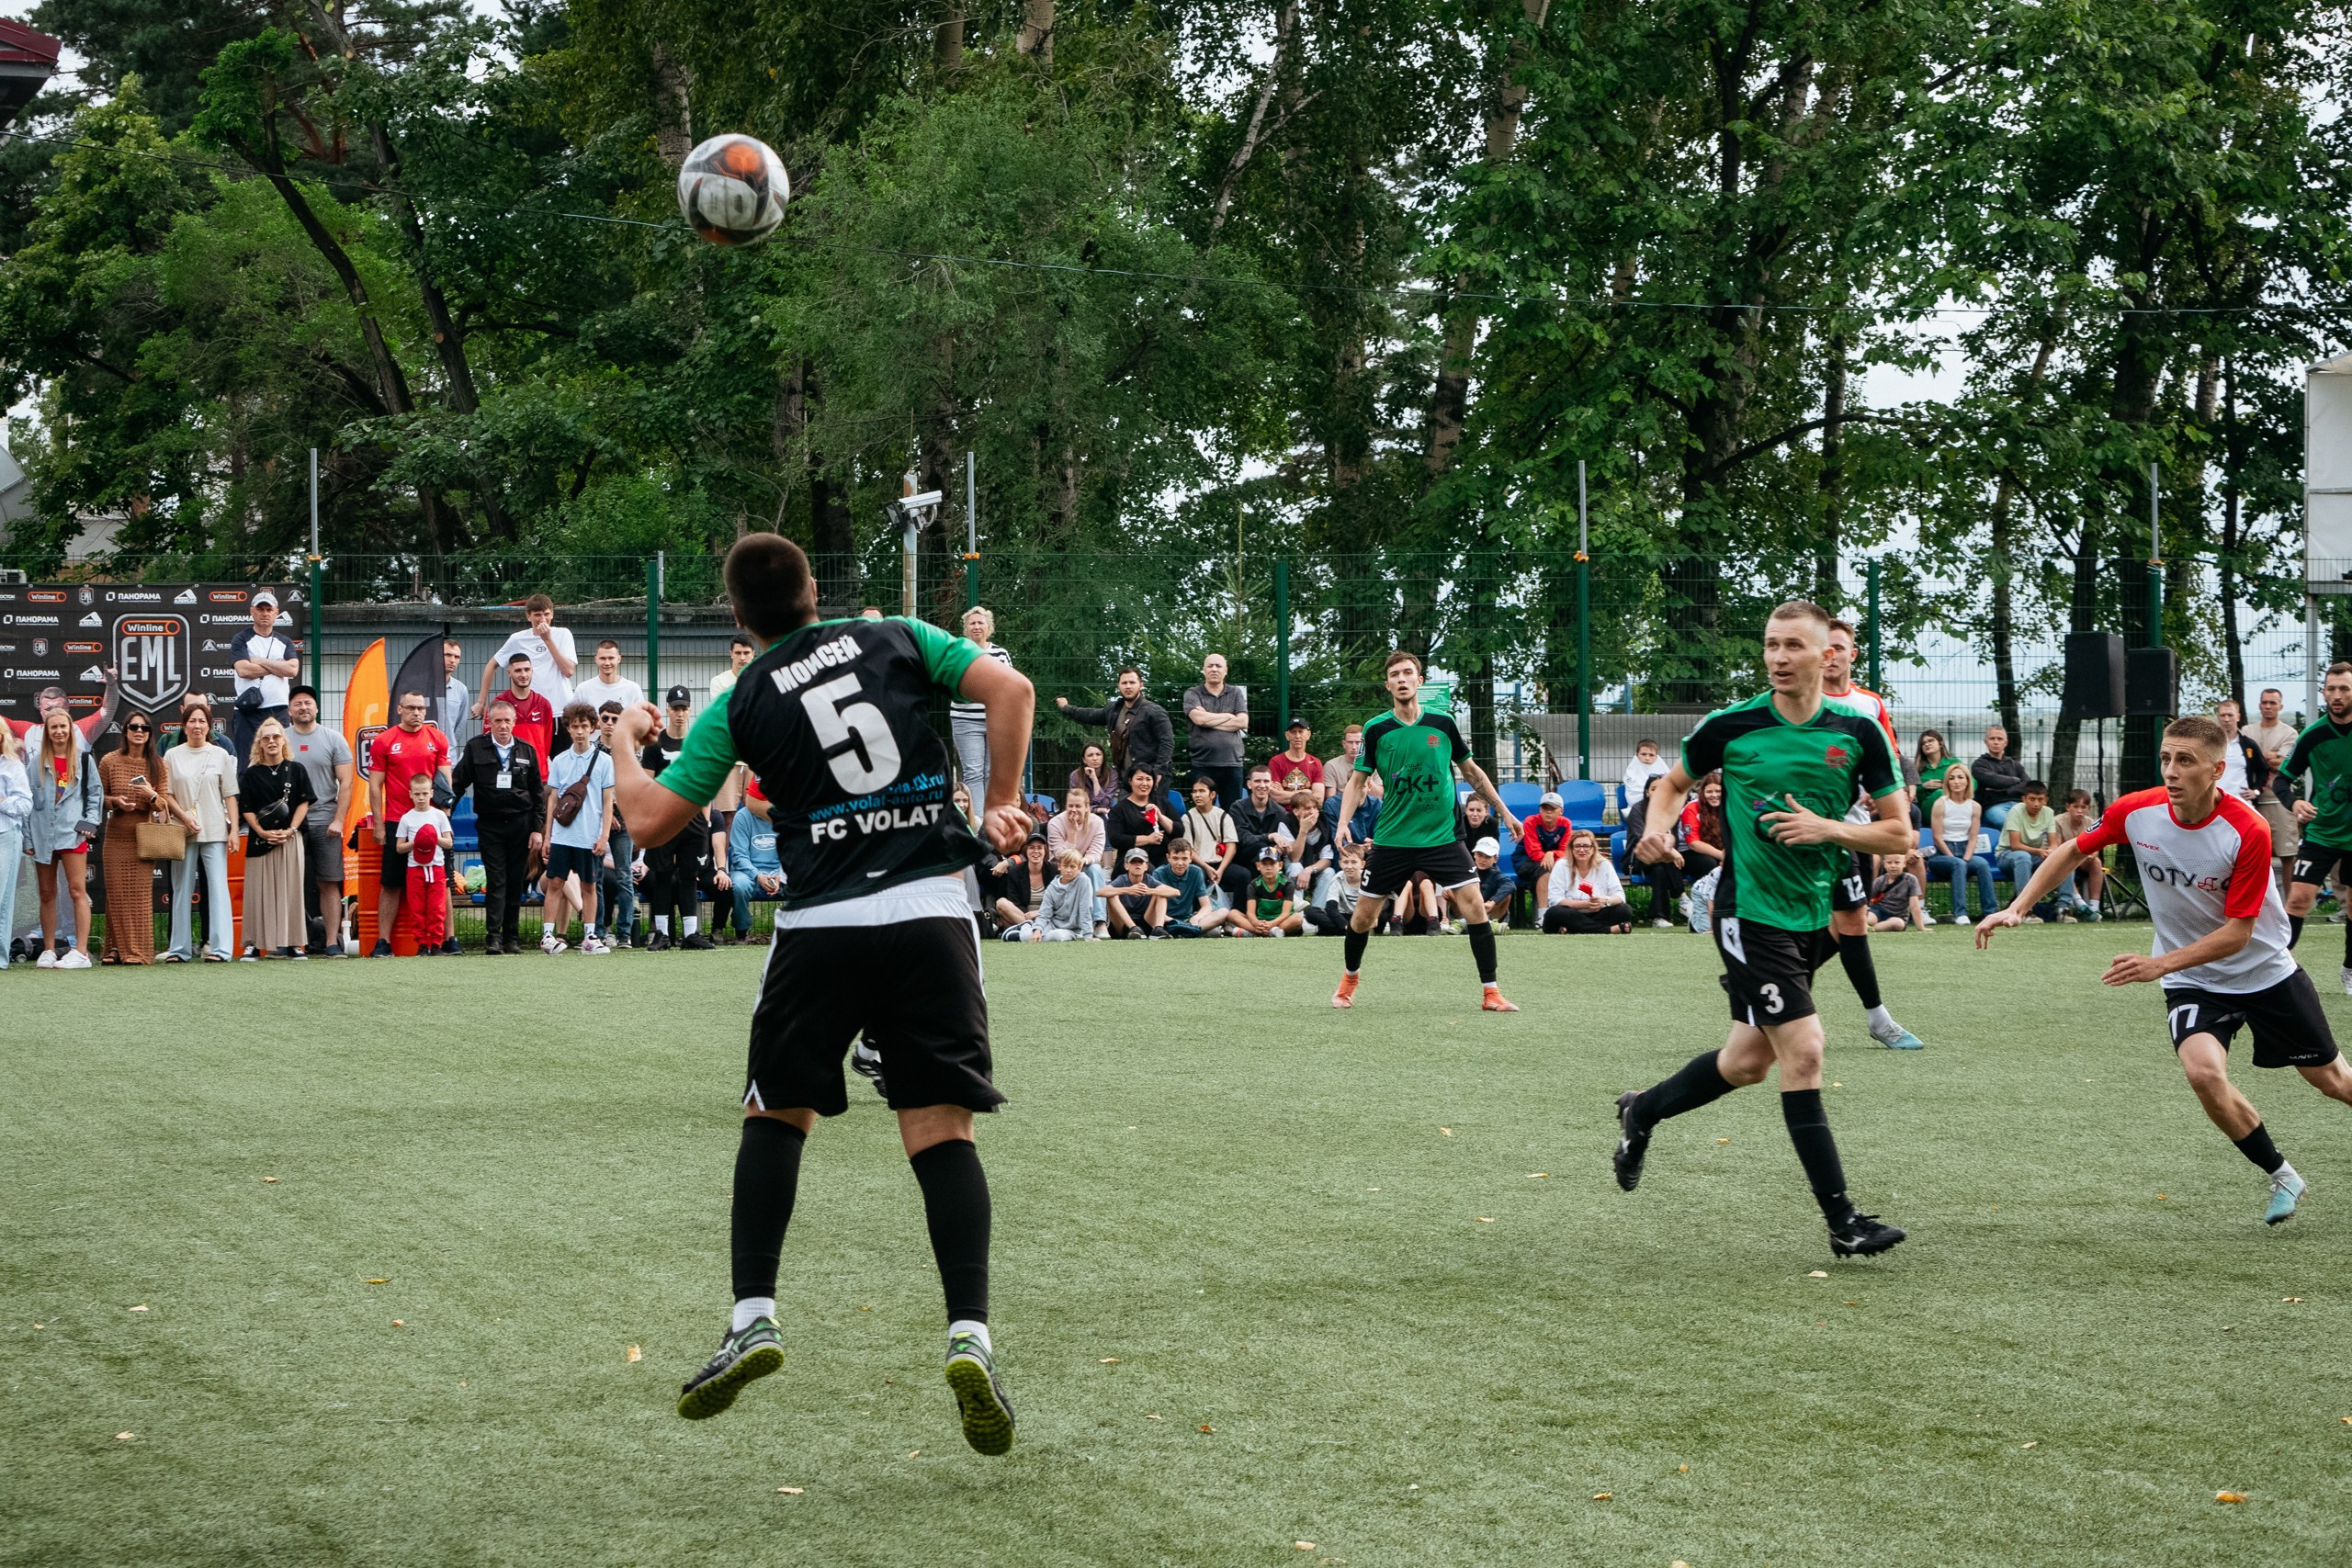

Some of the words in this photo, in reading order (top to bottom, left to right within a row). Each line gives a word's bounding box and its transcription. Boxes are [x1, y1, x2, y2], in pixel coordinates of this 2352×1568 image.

[127, 624, 164, 632] Winline
[120, 635, 182, 681] EML
[799, 671, 902, 795] 5
[808, 789, 944, 822] www.volat-auto.ru
[810, 818, 848, 844] FC
[854, 803, 944, 835] VOLAT
[2136, 840, 2160, 852] MAVEX
[1361, 868, 1372, 887] 5
[2293, 859, 2312, 876] 17
[1841, 874, 1867, 902] 12
[1759, 983, 1785, 1014] 3
